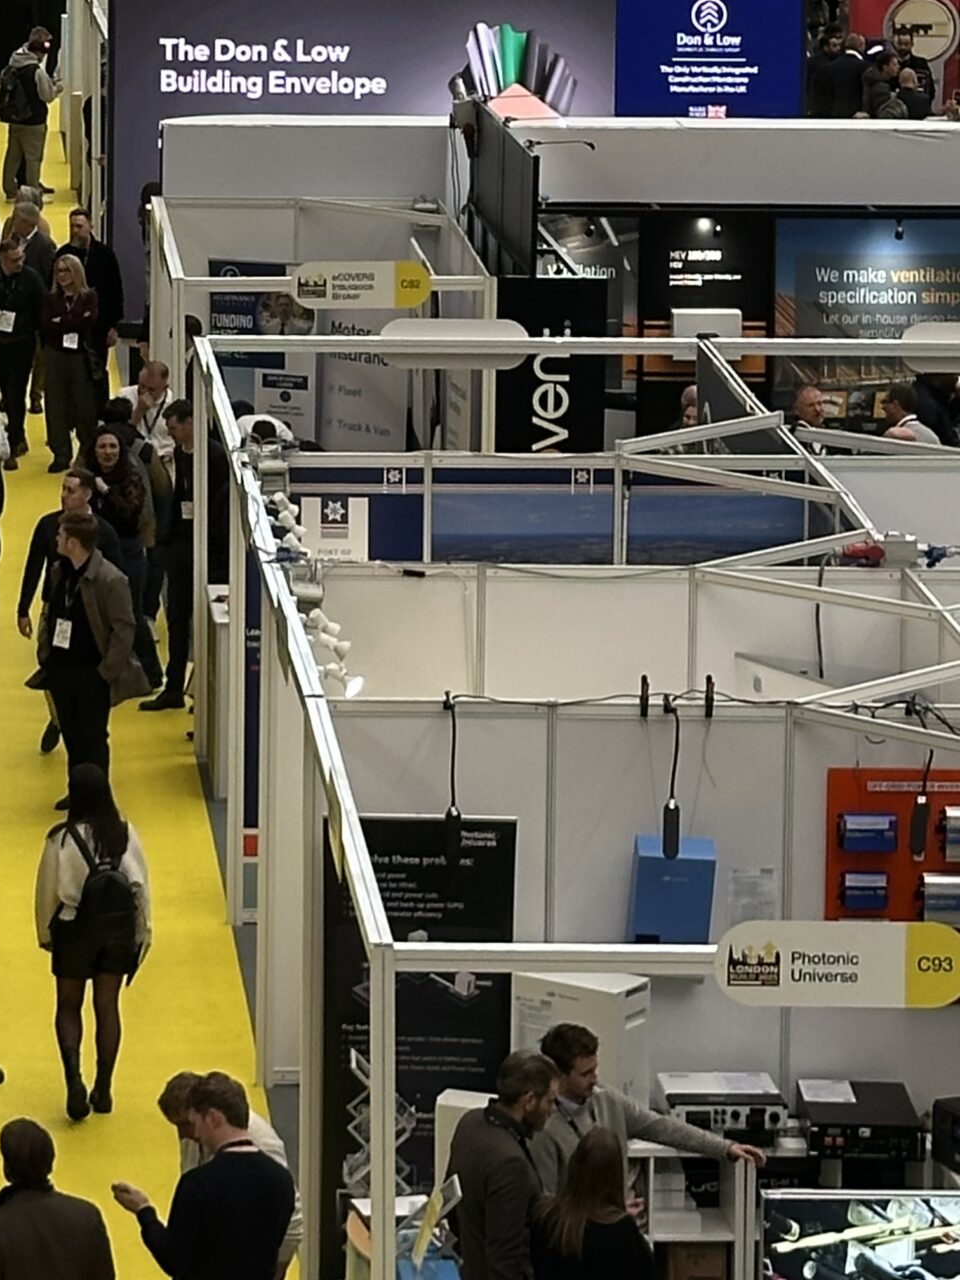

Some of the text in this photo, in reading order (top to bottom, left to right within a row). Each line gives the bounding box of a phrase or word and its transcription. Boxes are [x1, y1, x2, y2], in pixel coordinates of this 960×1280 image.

[676, 32, 742, 46] Don & Low
[159, 37, 351, 63] The Don & Low
[159, 69, 388, 100] Building Envelope
[815, 267, 839, 283] We
[843, 267, 887, 284] make
[819, 287, 917, 307] specification
[823, 312, 839, 325] Let
[841, 314, 861, 325] our
[861, 312, 908, 325] in-house
[330, 321, 373, 336] Motor
[329, 352, 389, 367] Insuran
[337, 385, 363, 398] Fleet
[336, 419, 364, 432] Truck
[391, 854, 421, 865] these
[729, 965, 779, 973] LONDON
[790, 950, 954, 973] Photonic C93
[790, 969, 859, 984] Universe
